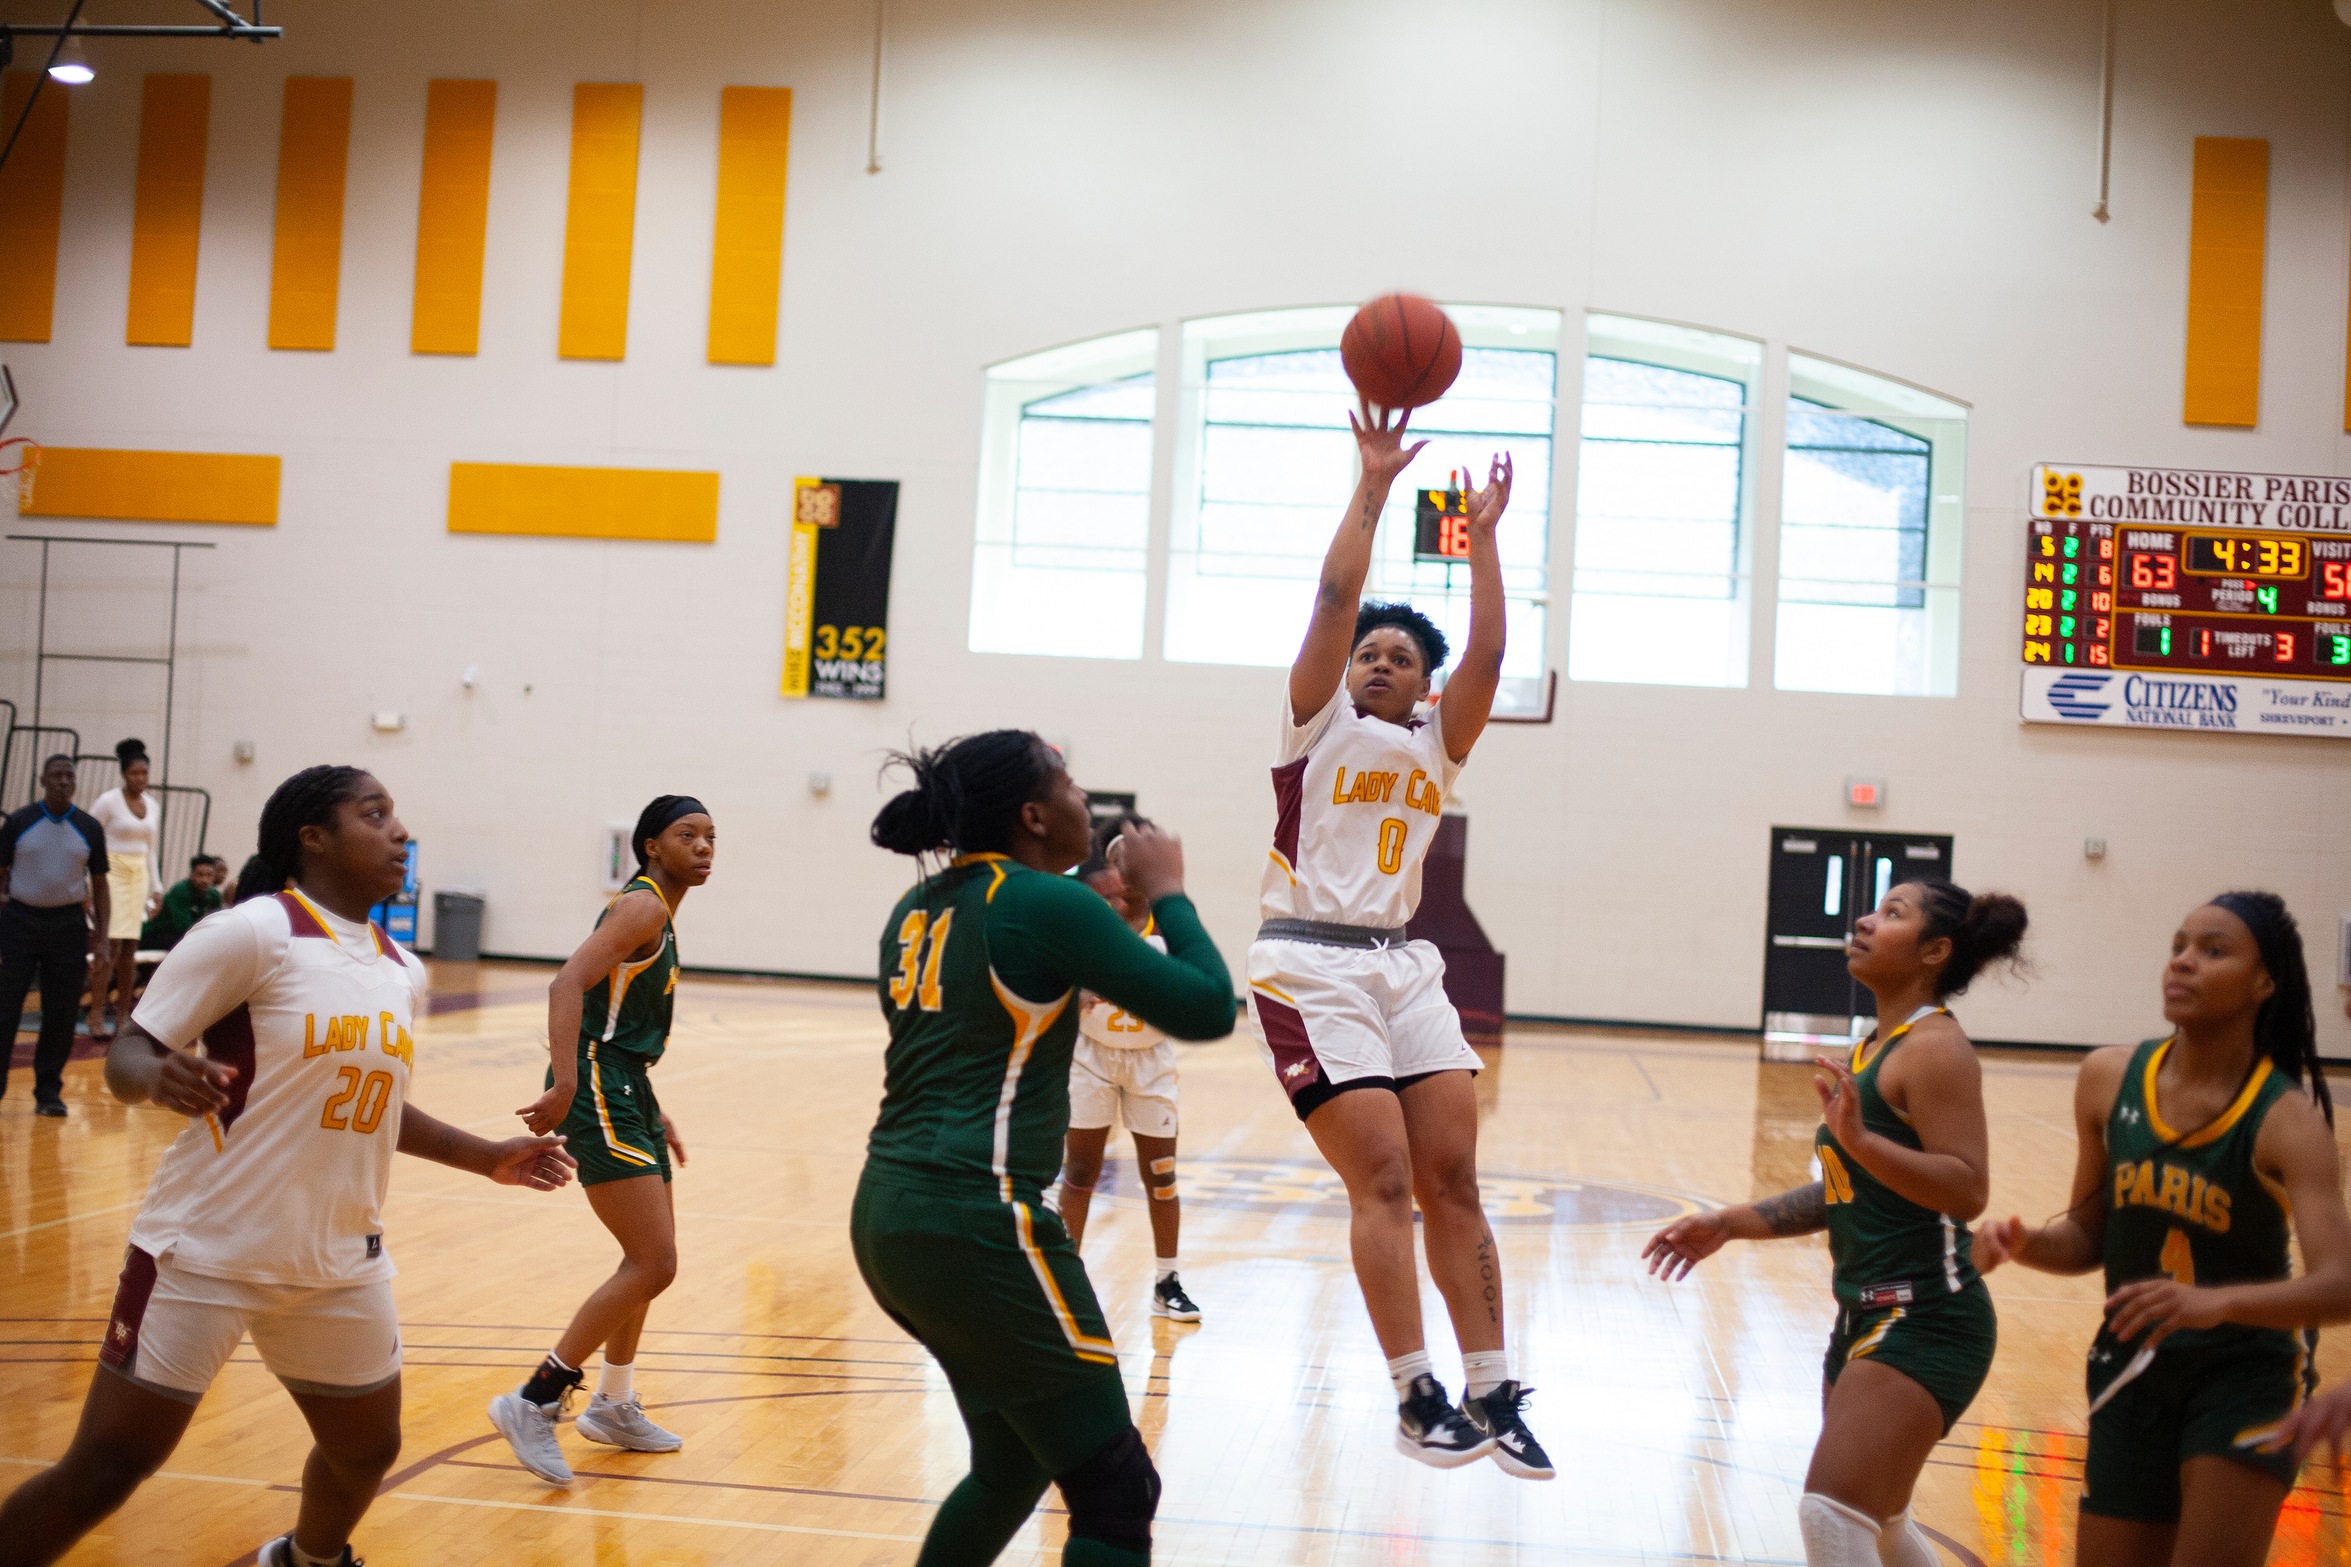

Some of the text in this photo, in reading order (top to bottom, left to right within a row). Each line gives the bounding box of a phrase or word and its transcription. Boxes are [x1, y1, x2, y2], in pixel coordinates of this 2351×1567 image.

[2128, 471, 2351, 505] BOSSIER PARIS
[2090, 495, 2267, 526] COMMUNITY
[2041, 536, 2055, 557] 5
[2100, 538, 2114, 559] 8
[2127, 531, 2174, 550] HOME
[2132, 553, 2176, 590] 63
[2213, 539, 2300, 575] 4:33
[2097, 565, 2112, 586] 6
[2092, 591, 2111, 612] 10
[2141, 592, 2181, 608] BONUS
[2257, 586, 2278, 615] 4
[2306, 601, 2347, 616] BONUS
[2096, 617, 2110, 638] 2
[2160, 627, 2171, 656] 1
[2214, 630, 2272, 648] TIMEOUTS
[816, 624, 886, 661] 352
[2065, 642, 2075, 664] 1
[2089, 643, 2109, 665] 15
[2201, 629, 2210, 657] 1
[2227, 644, 2256, 659] LEFT
[2275, 631, 2295, 663] 3
[2331, 634, 2351, 665] 3
[814, 658, 884, 683] WINS
[2125, 674, 2238, 713] CITIZENS
[2127, 709, 2237, 729] NATIONAL BANK
[1332, 766, 1399, 805] LADY
[1377, 817, 1408, 875] 0
[889, 906, 955, 1012] 31
[303, 1013, 369, 1059] LADY
[320, 1066, 394, 1134] 20
[2114, 1159, 2232, 1234] PARIS
